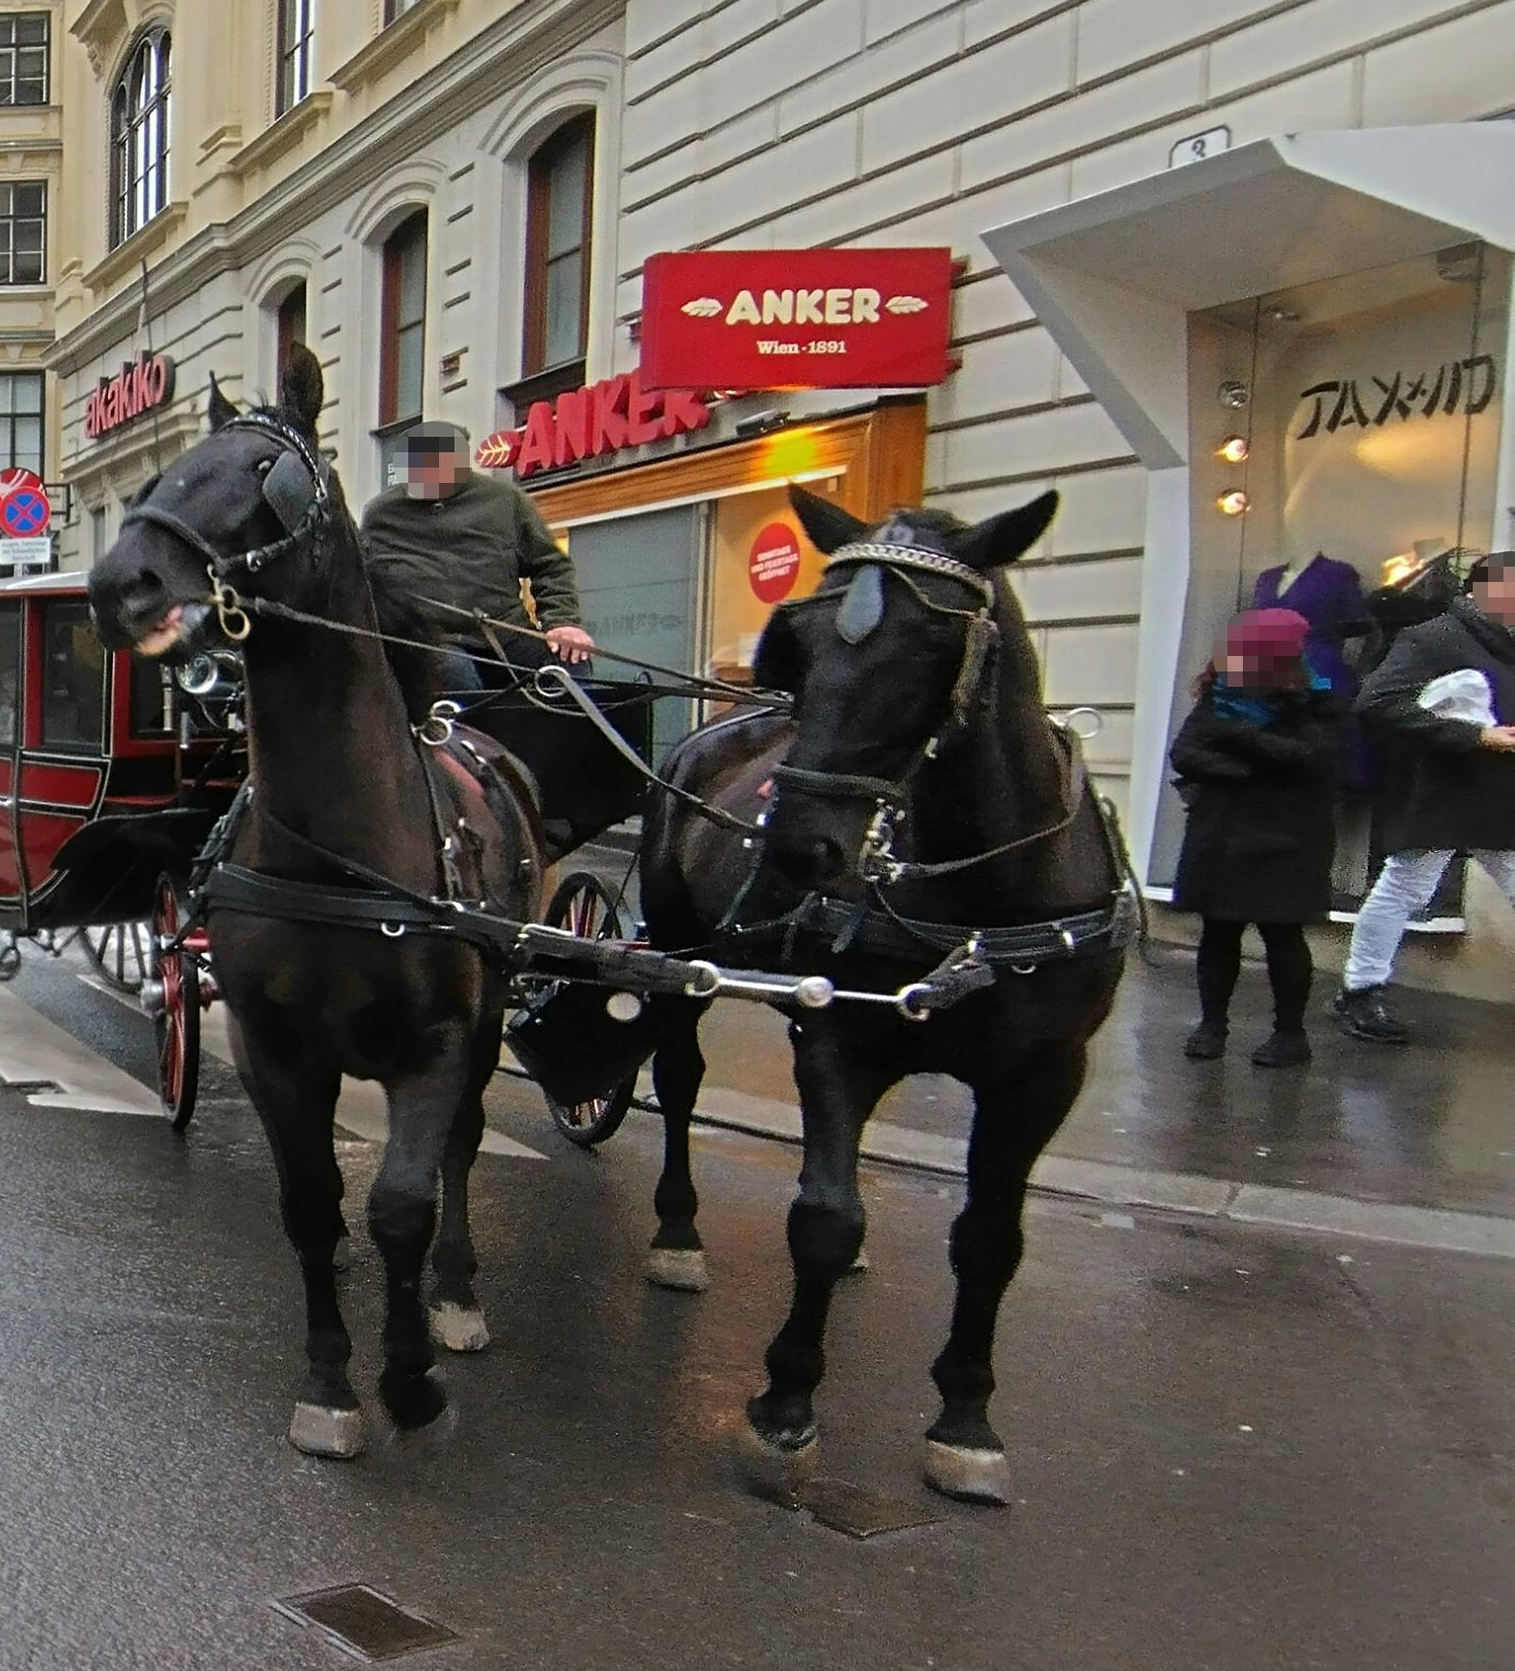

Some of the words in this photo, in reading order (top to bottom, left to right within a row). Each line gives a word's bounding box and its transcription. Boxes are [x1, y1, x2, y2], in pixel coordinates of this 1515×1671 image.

[1191, 138, 1205, 158] 3
[725, 288, 881, 326] ANKER
[756, 340, 800, 354] Wien
[808, 340, 846, 353] 1891
[85, 349, 173, 439] akakiko
